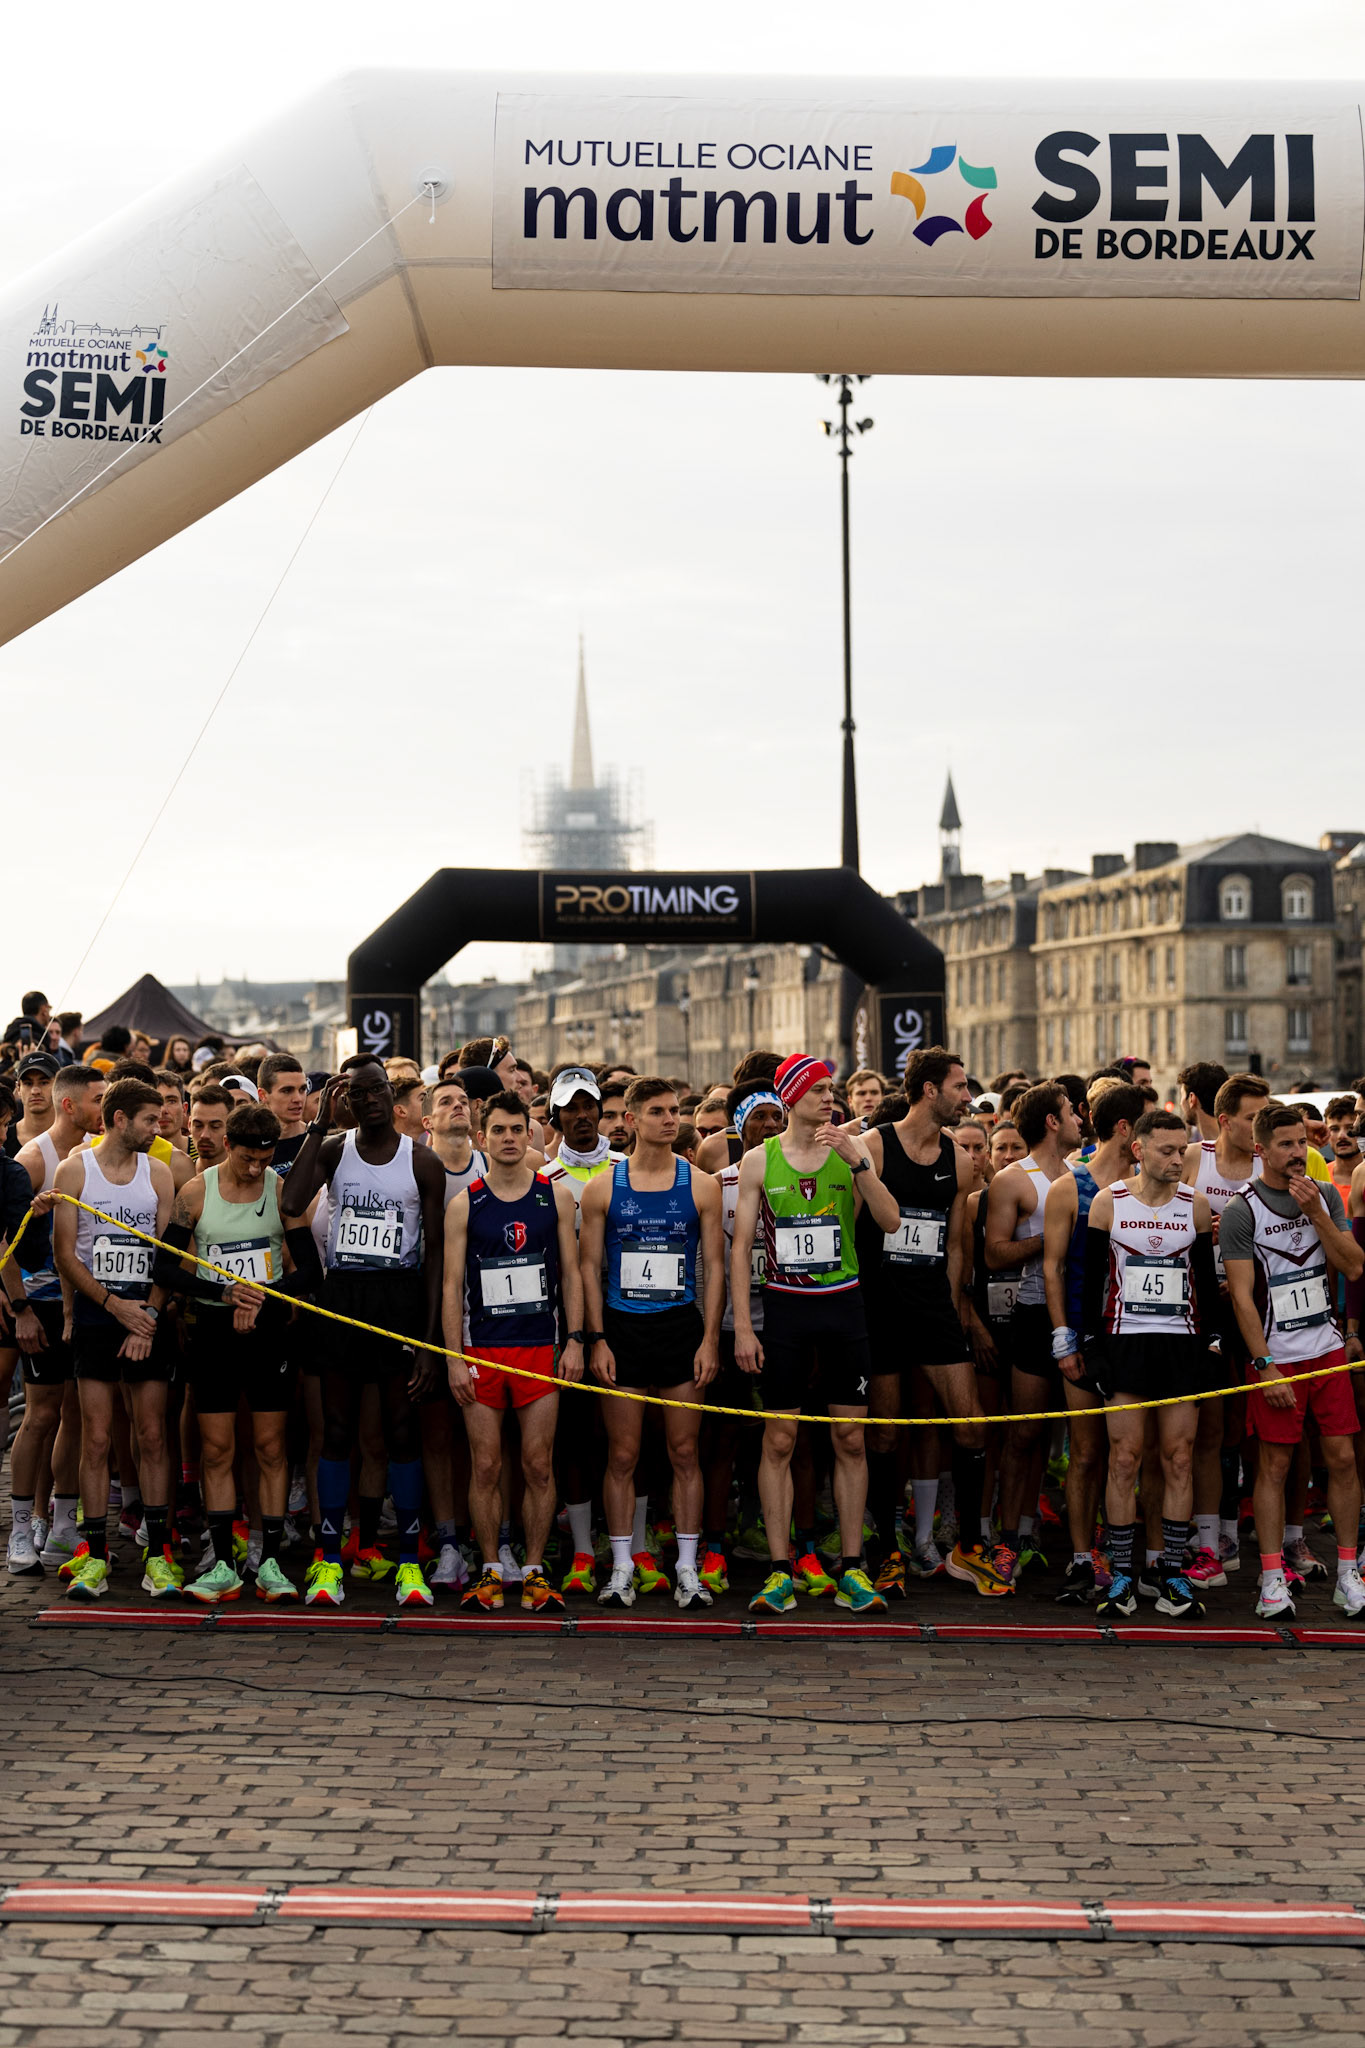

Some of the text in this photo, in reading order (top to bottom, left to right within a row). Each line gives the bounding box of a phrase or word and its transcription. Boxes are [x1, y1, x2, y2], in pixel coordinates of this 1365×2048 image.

[525, 139, 874, 172] MUTUELLE OCIANE
[1031, 130, 1316, 223] SEMI
[523, 176, 875, 246] matmut
[1034, 229, 1317, 261] DE BORDEAUX
[29, 338, 132, 350] MUTUELLE OCIANE
[26, 349, 131, 373] matmut
[20, 368, 167, 425] SEMI
[20, 419, 164, 444] DE BORDEAUX
[555, 885, 740, 914] PROTIMING
[340, 1222, 391, 1249] 15016
[903, 1224, 921, 1246] 14
[1120, 1220, 1188, 1232] BORDEAUX
[794, 1233, 814, 1256] 18
[94, 1251, 146, 1275] 15015
[642, 1259, 653, 1281] 4
[505, 1274, 513, 1296] 1
[1142, 1273, 1165, 1296] 45
[1290, 1287, 1310, 1311] 11
